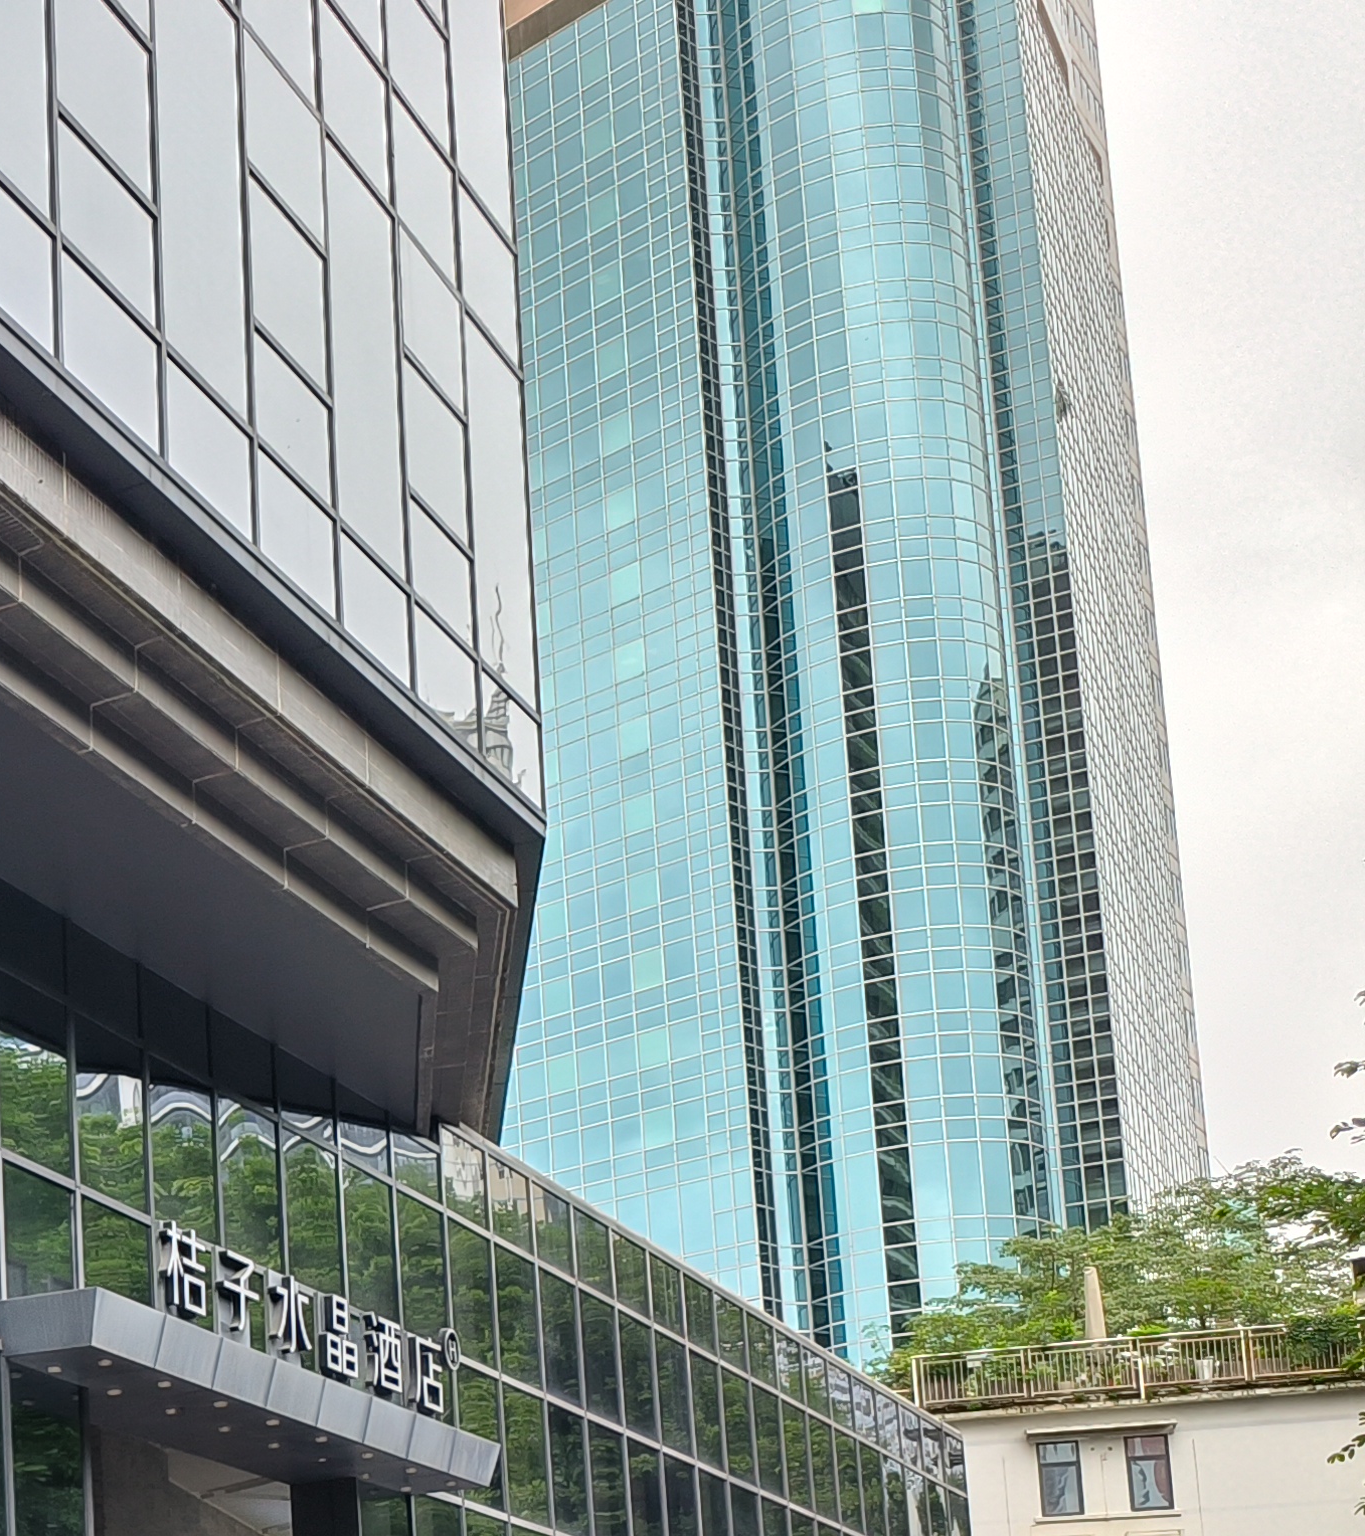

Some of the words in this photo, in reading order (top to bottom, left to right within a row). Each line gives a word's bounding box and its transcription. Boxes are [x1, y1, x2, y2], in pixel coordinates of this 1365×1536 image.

[164, 1220, 445, 1414] 桔子水晶酒店
